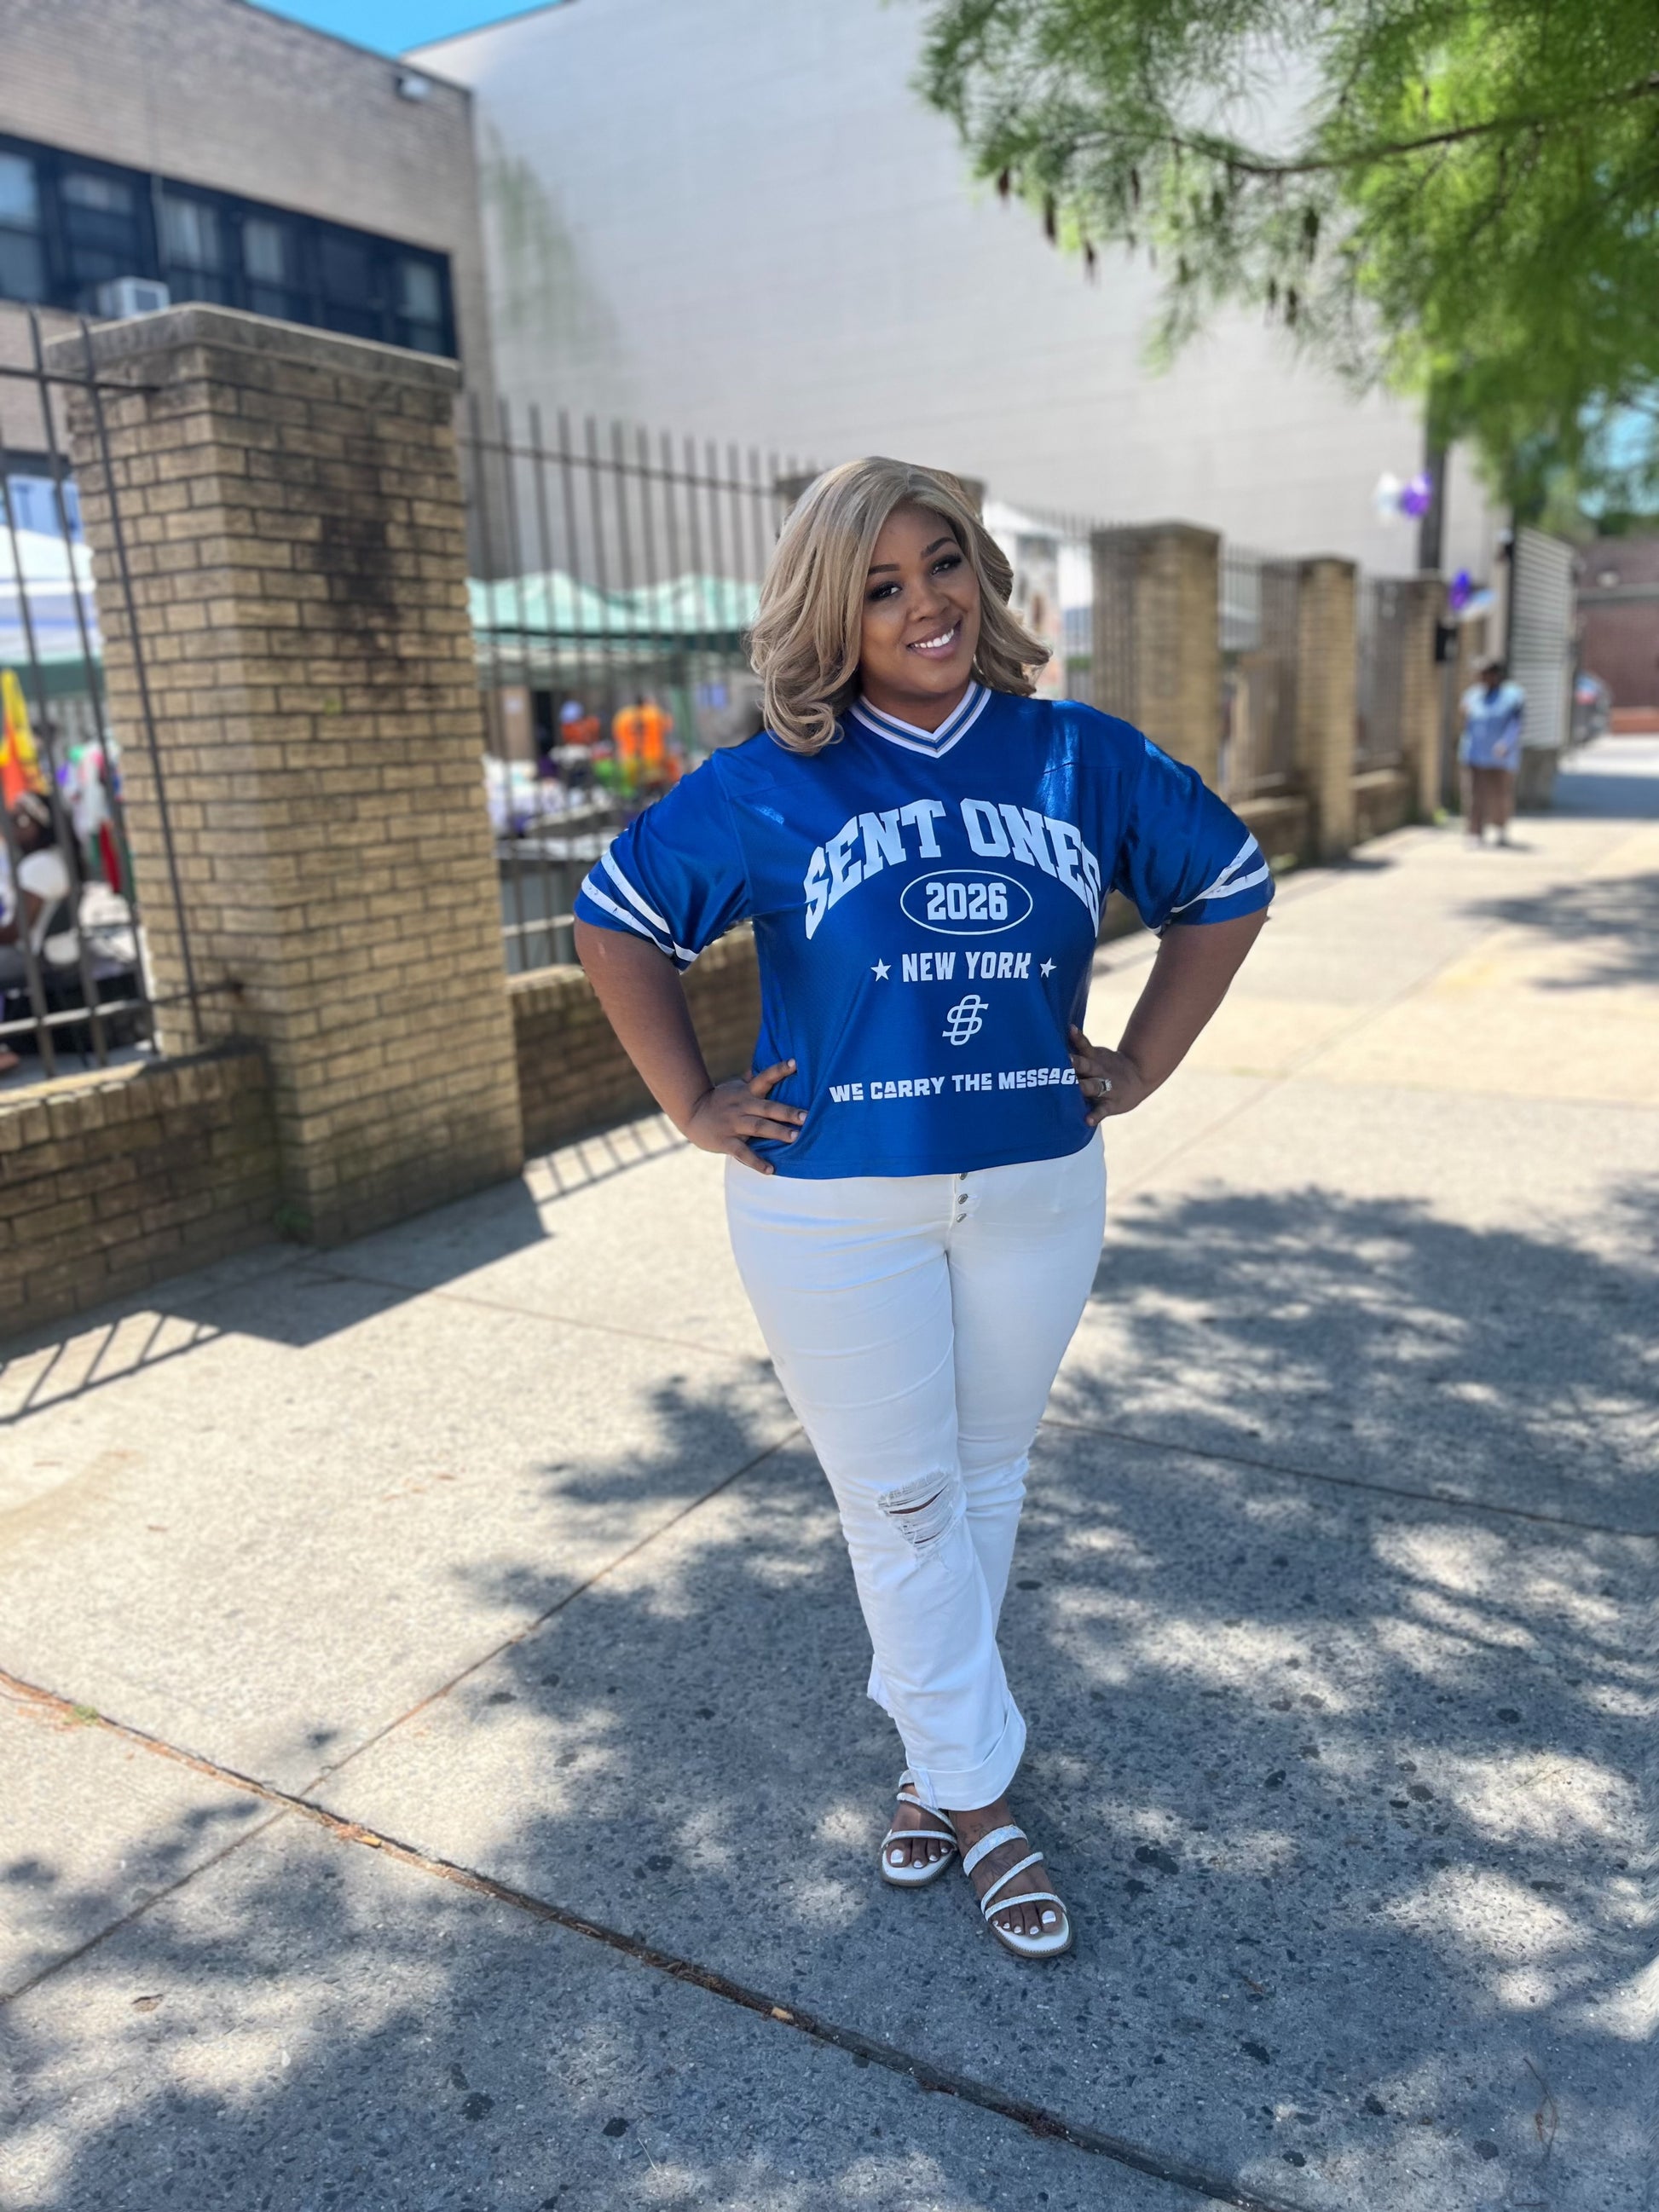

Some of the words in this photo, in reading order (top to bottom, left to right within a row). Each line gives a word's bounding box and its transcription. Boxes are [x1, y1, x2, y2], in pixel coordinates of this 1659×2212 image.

[804, 799, 946, 939] SENT
[960, 799, 1101, 938] ONES
[926, 883, 1009, 921] 2026
[902, 952, 957, 983] NEW
[965, 952, 1032, 979] YORK
[829, 1083, 864, 1103] WE
[870, 1077, 945, 1100] CARRY
[951, 1073, 992, 1092] THE
[998, 1067, 1079, 1090] MESSAG
